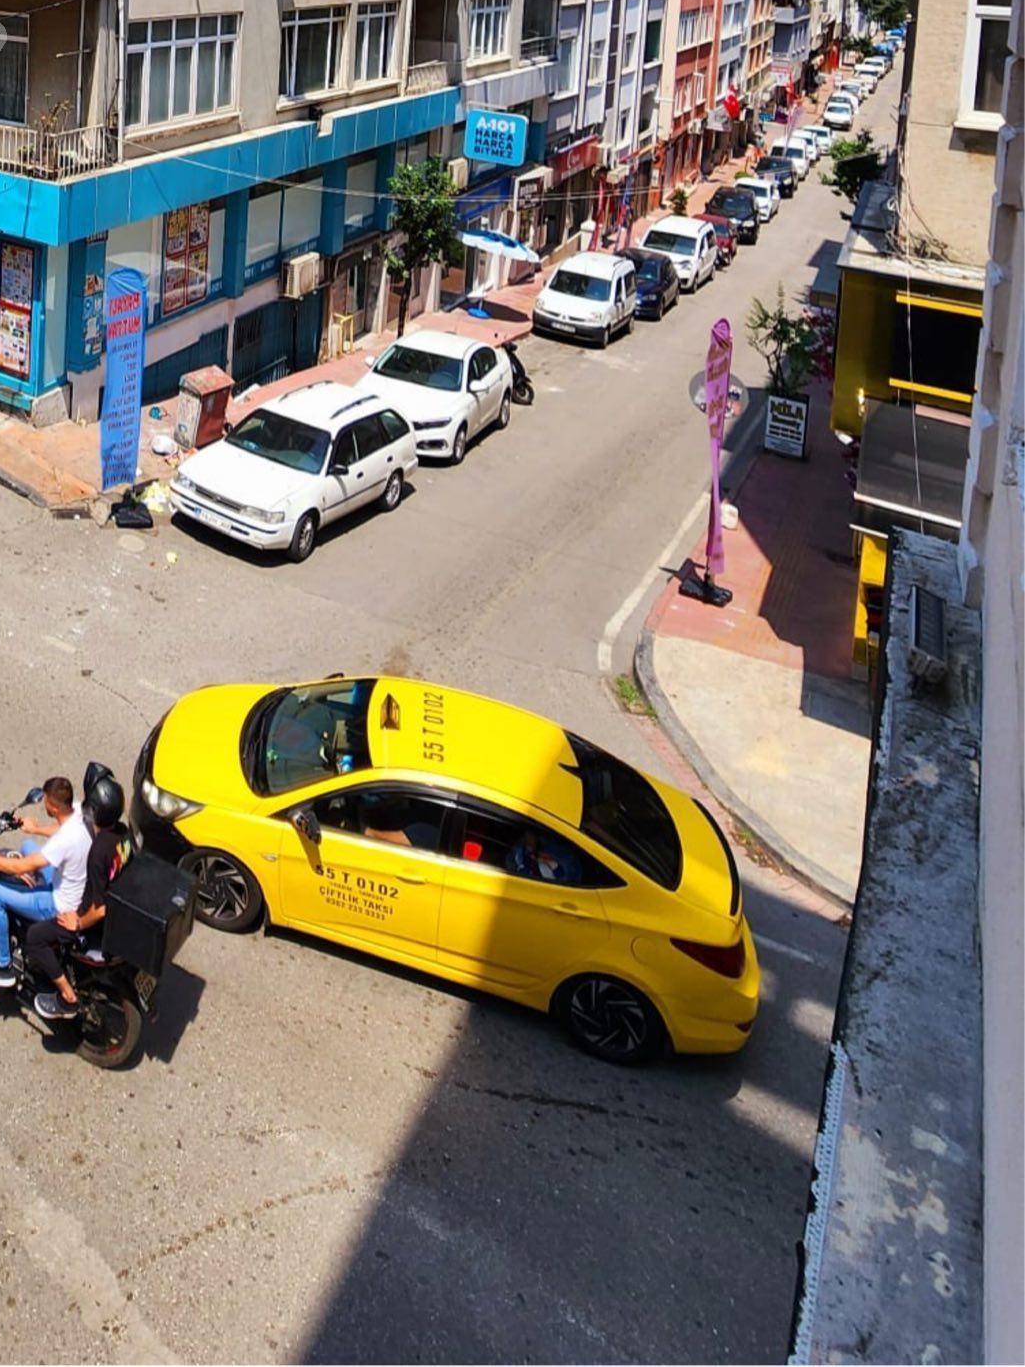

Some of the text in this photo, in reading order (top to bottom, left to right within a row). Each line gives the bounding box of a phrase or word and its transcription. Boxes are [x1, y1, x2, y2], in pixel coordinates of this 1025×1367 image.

[422, 692, 444, 762] 55 T 0102
[342, 870, 351, 884] T
[356, 877, 399, 899] 0102
